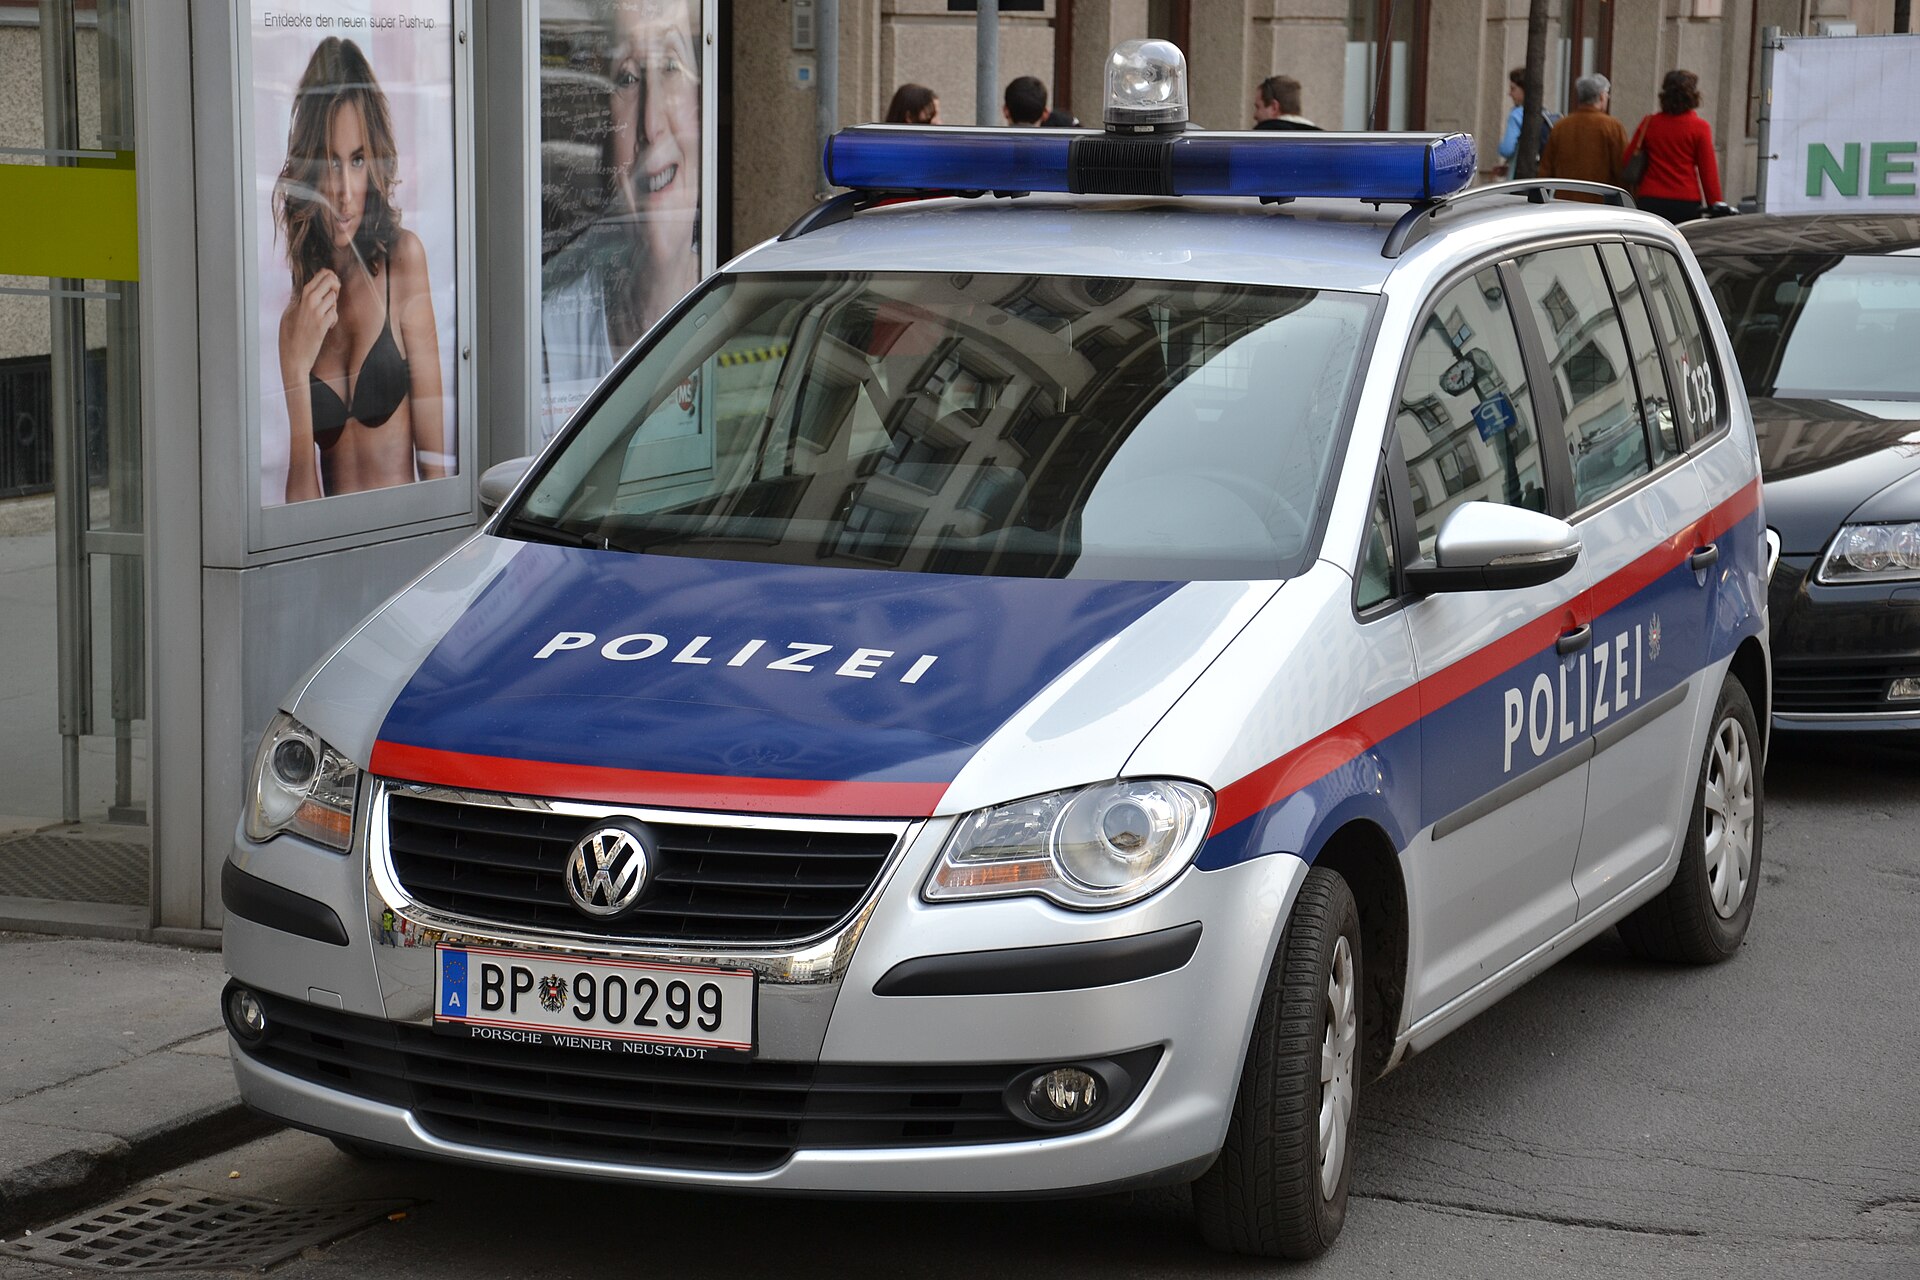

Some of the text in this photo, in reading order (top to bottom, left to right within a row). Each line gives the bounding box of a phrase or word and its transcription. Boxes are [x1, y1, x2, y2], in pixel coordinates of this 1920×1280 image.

[264, 12, 437, 31] Entdecke den neuen super Push-up.
[533, 632, 938, 684] POLIZEI
[1504, 624, 1642, 773] POLIZEI
[448, 991, 461, 1008] A
[480, 962, 723, 1032] BP 90299
[471, 1026, 708, 1060] PORSCHE WIENER NEUSTADT
